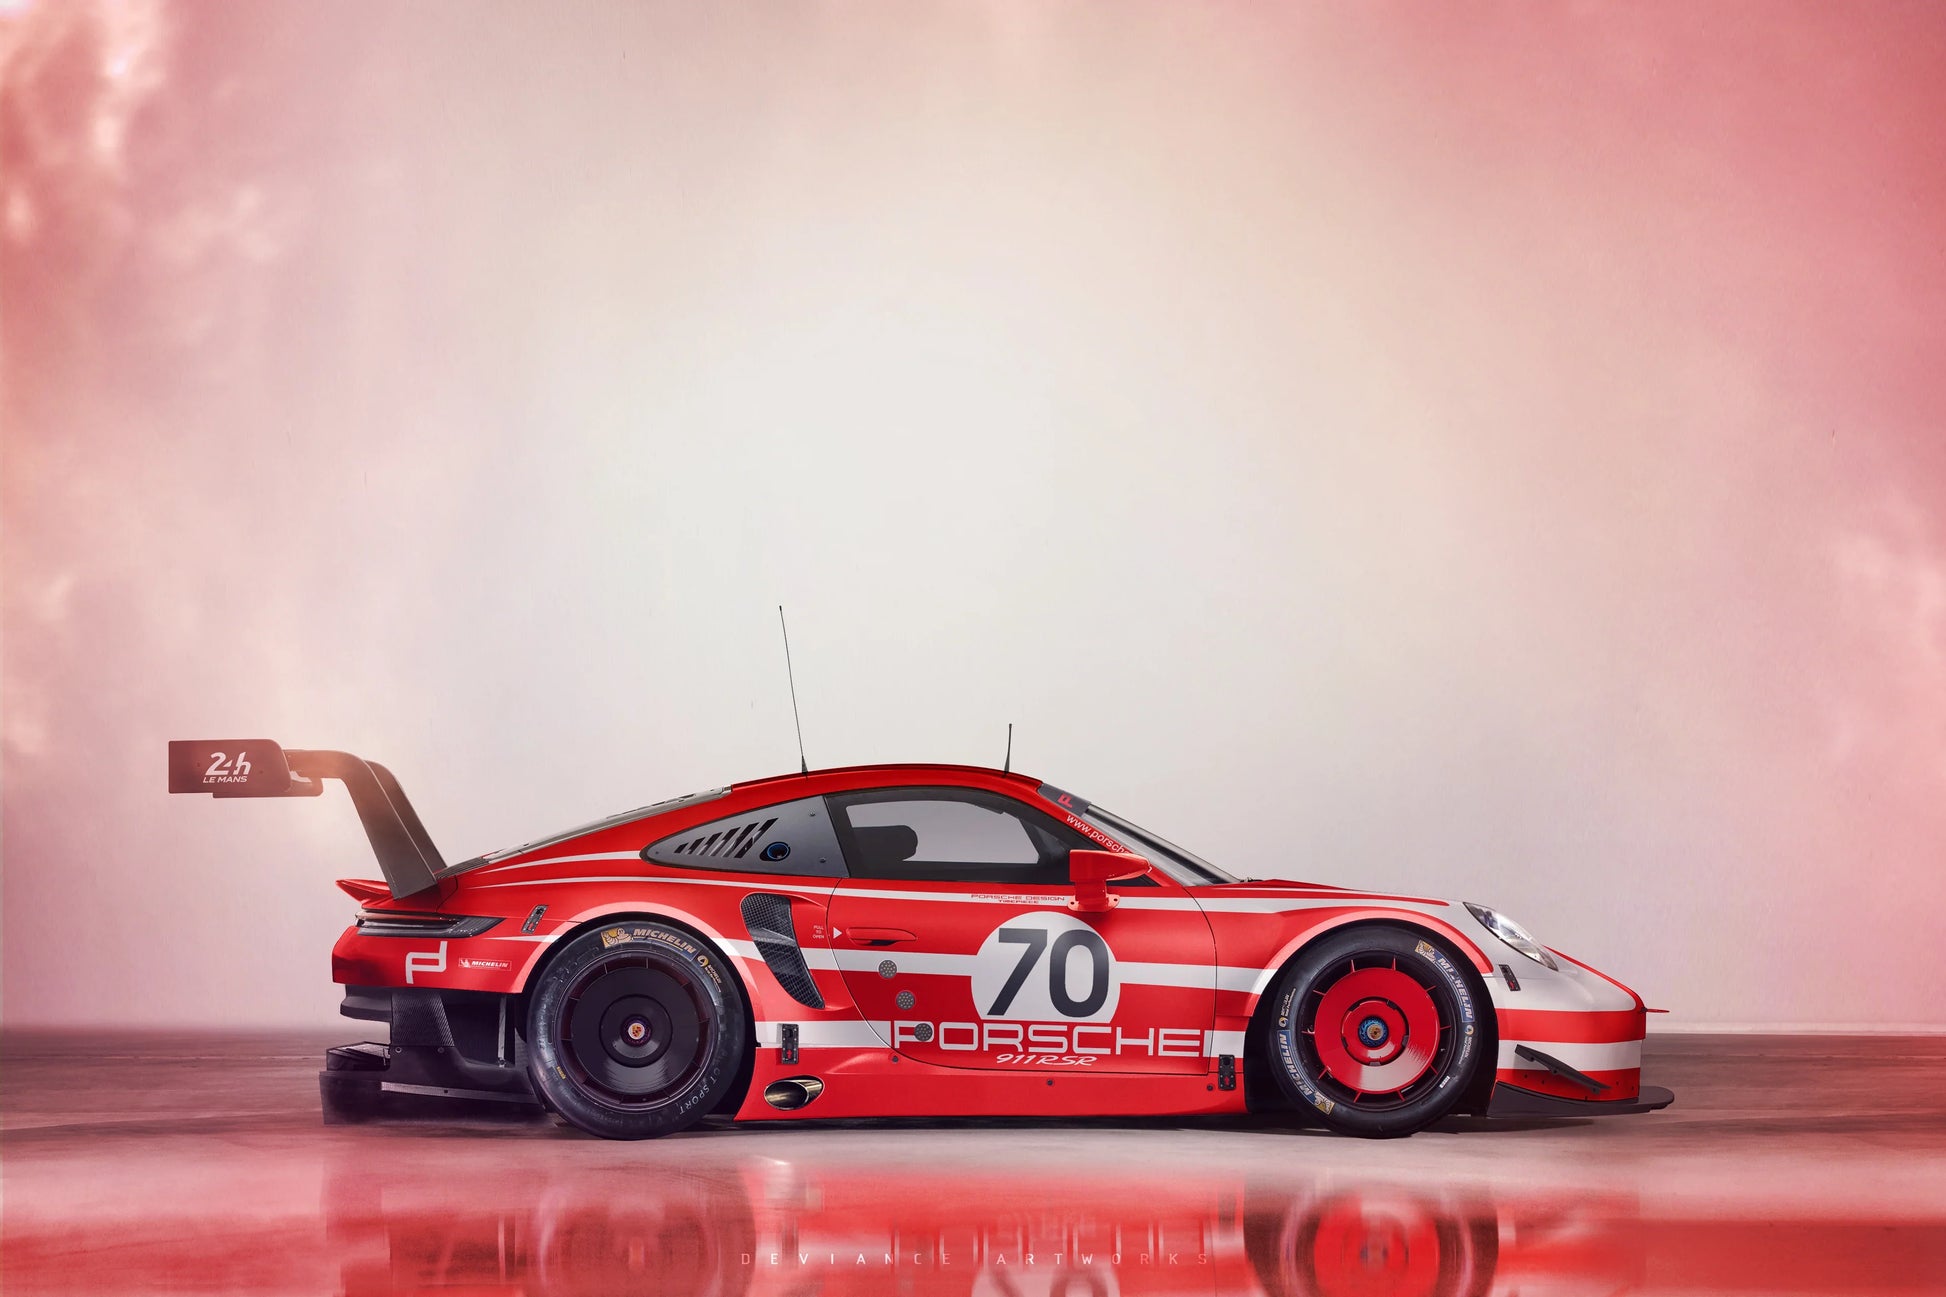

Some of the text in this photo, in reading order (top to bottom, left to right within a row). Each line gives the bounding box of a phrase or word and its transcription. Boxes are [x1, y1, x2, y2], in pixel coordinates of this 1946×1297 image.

[202, 775, 248, 784] LE MANS
[1066, 814, 1130, 854] www.porsch
[633, 928, 697, 954] MICHELIN
[471, 960, 509, 968] MICHELIN
[986, 927, 1109, 1018] 70
[894, 1020, 1201, 1058] PORSCHE
[1279, 1032, 1313, 1097] MICHELIN
[679, 1084, 710, 1115] SPORT
